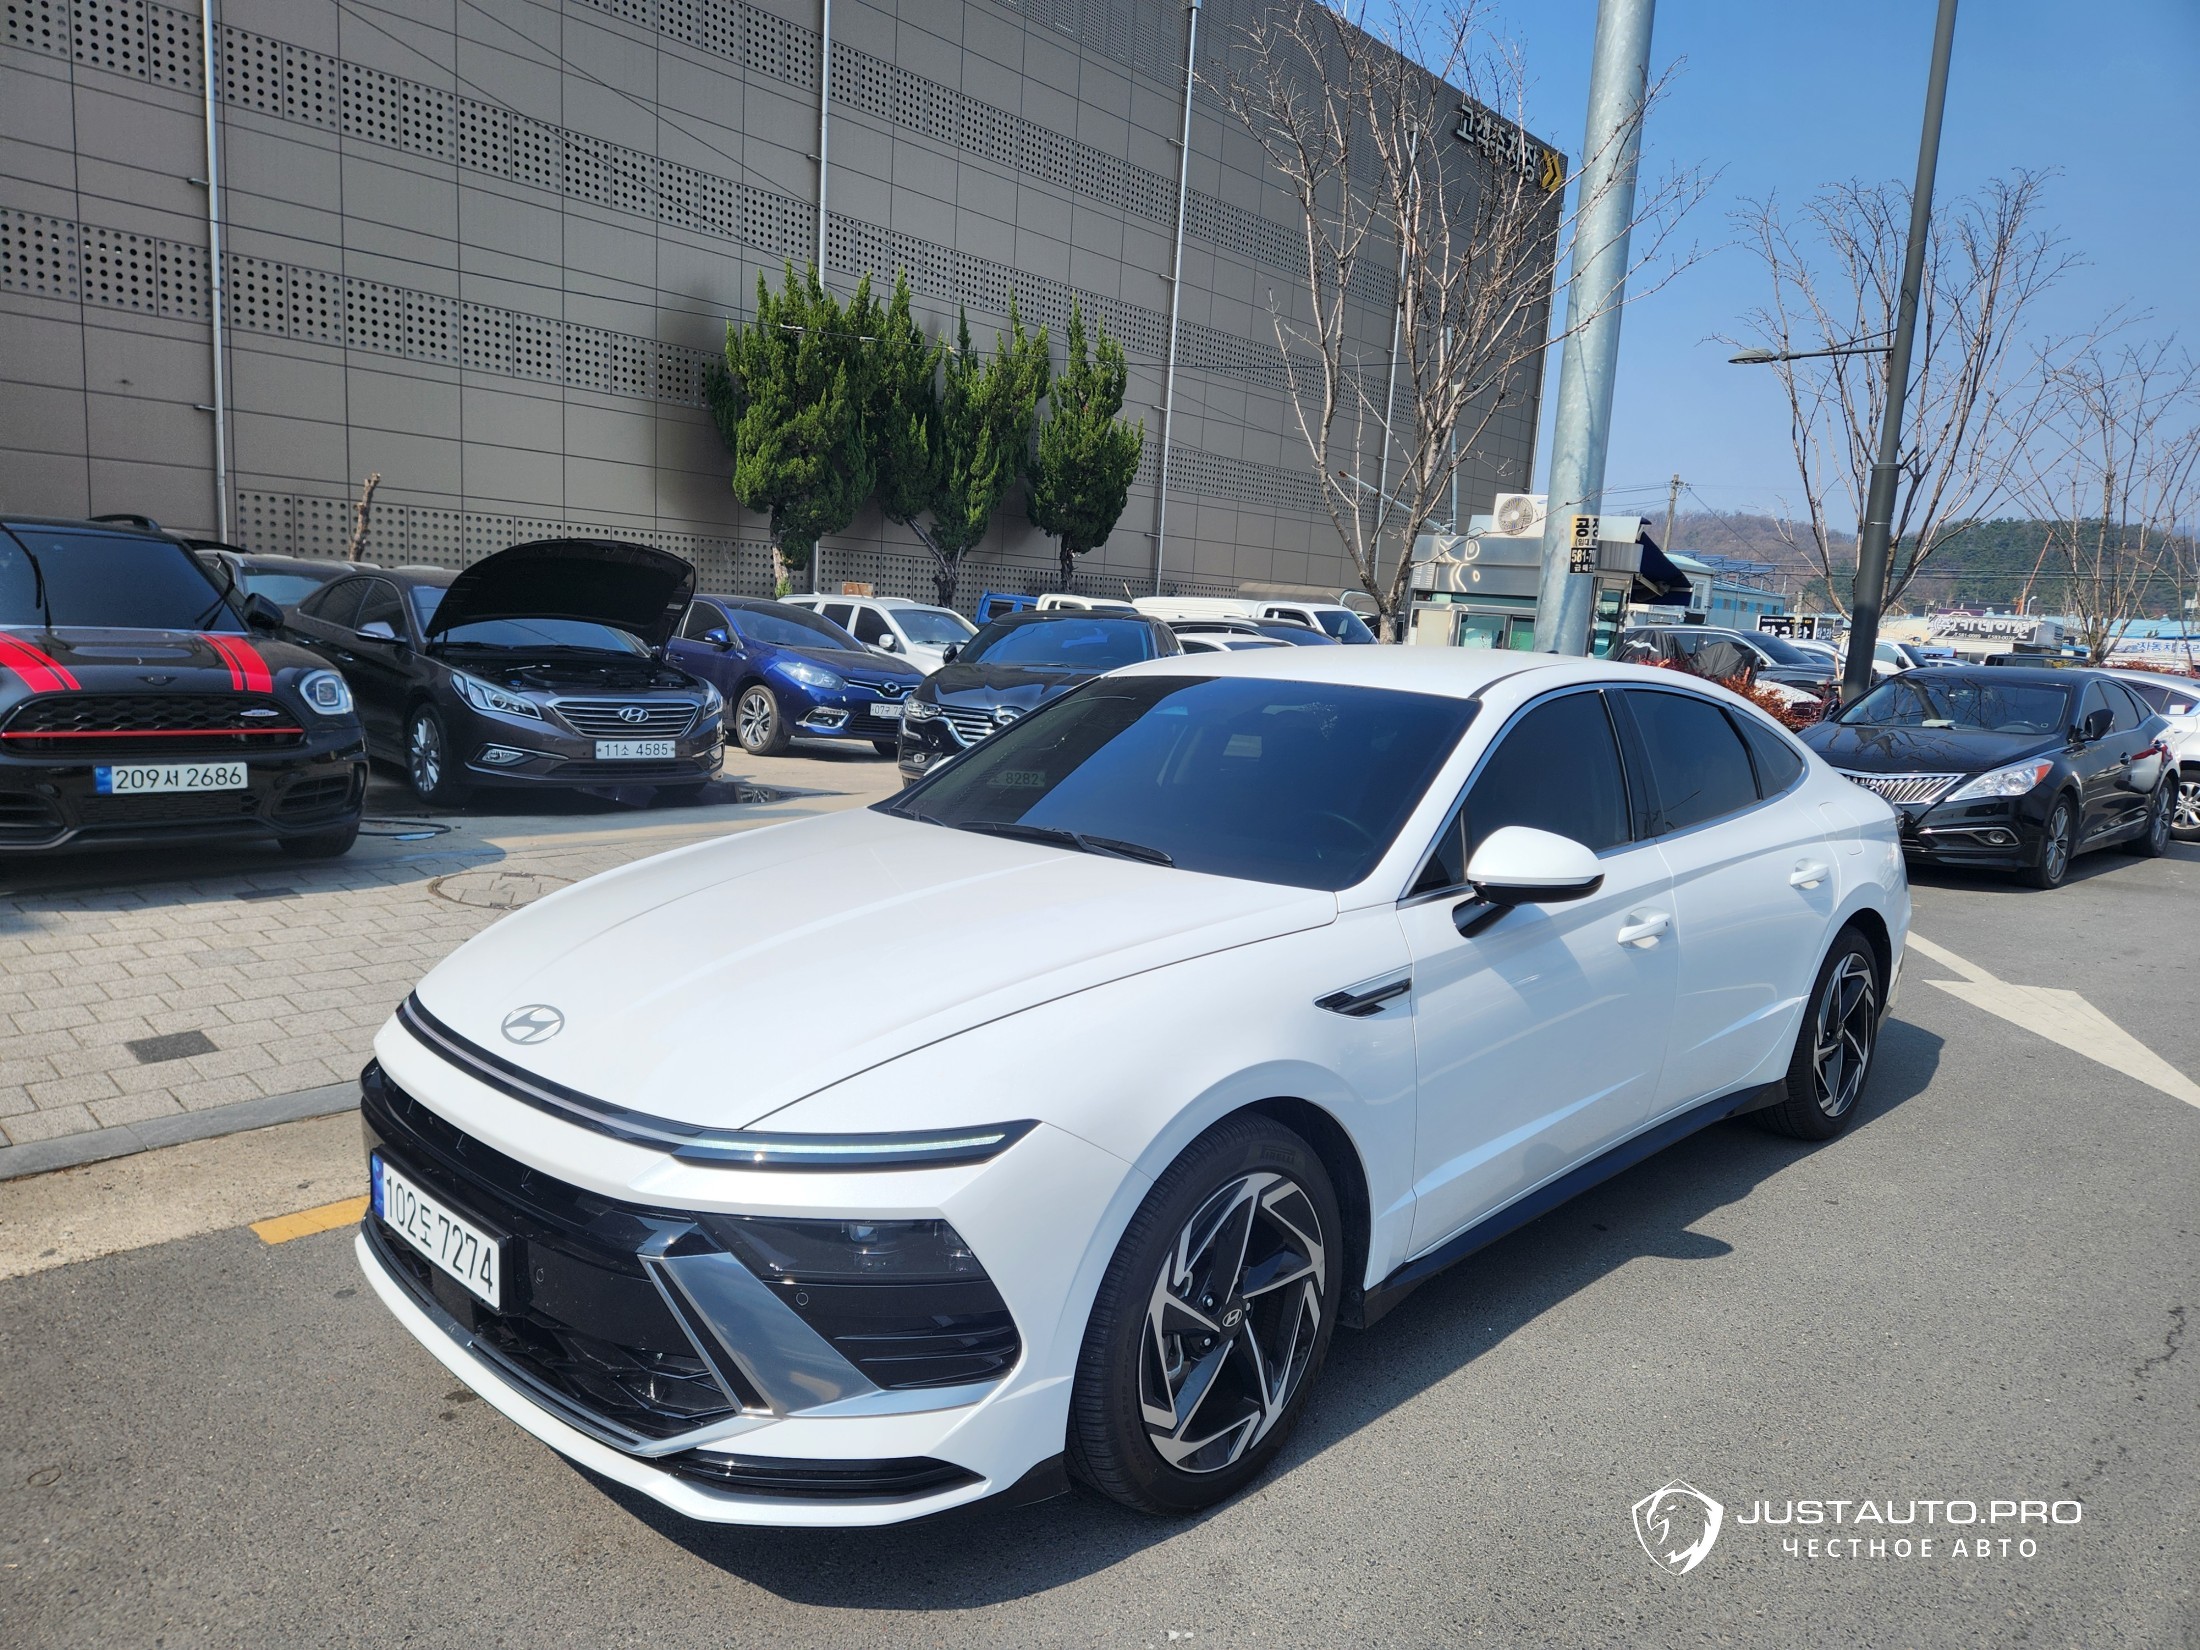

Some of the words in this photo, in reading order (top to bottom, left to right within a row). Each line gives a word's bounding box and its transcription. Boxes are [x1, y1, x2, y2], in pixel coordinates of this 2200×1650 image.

[604, 743, 629, 756] 11소
[635, 743, 668, 756] 4585
[116, 768, 179, 789] 209서
[186, 766, 242, 787] 2686
[1005, 772, 1039, 785] 8282
[386, 1175, 432, 1249] 102도
[438, 1213, 493, 1294] 7274
